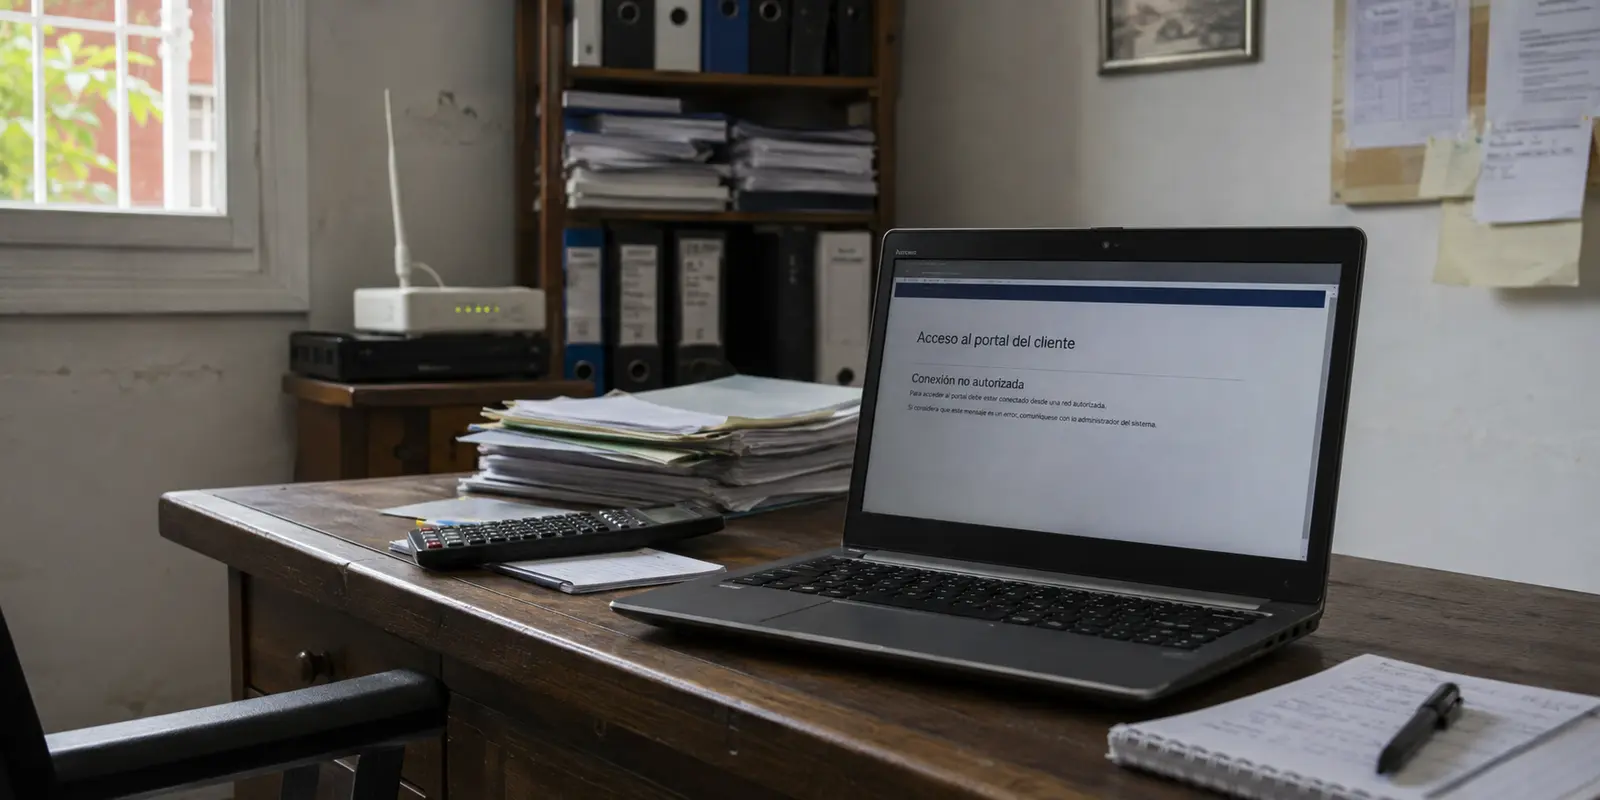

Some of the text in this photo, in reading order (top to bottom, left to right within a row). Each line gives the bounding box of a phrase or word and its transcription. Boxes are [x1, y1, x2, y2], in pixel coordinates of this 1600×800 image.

[916, 331, 1075, 349] Acceso al portal del cliente
[911, 373, 1025, 390] Conexión no autorizada
[951, 392, 967, 400] portal
[968, 393, 982, 401] debe
[999, 396, 1029, 404] conectado
[1078, 417, 1119, 425] administrador
